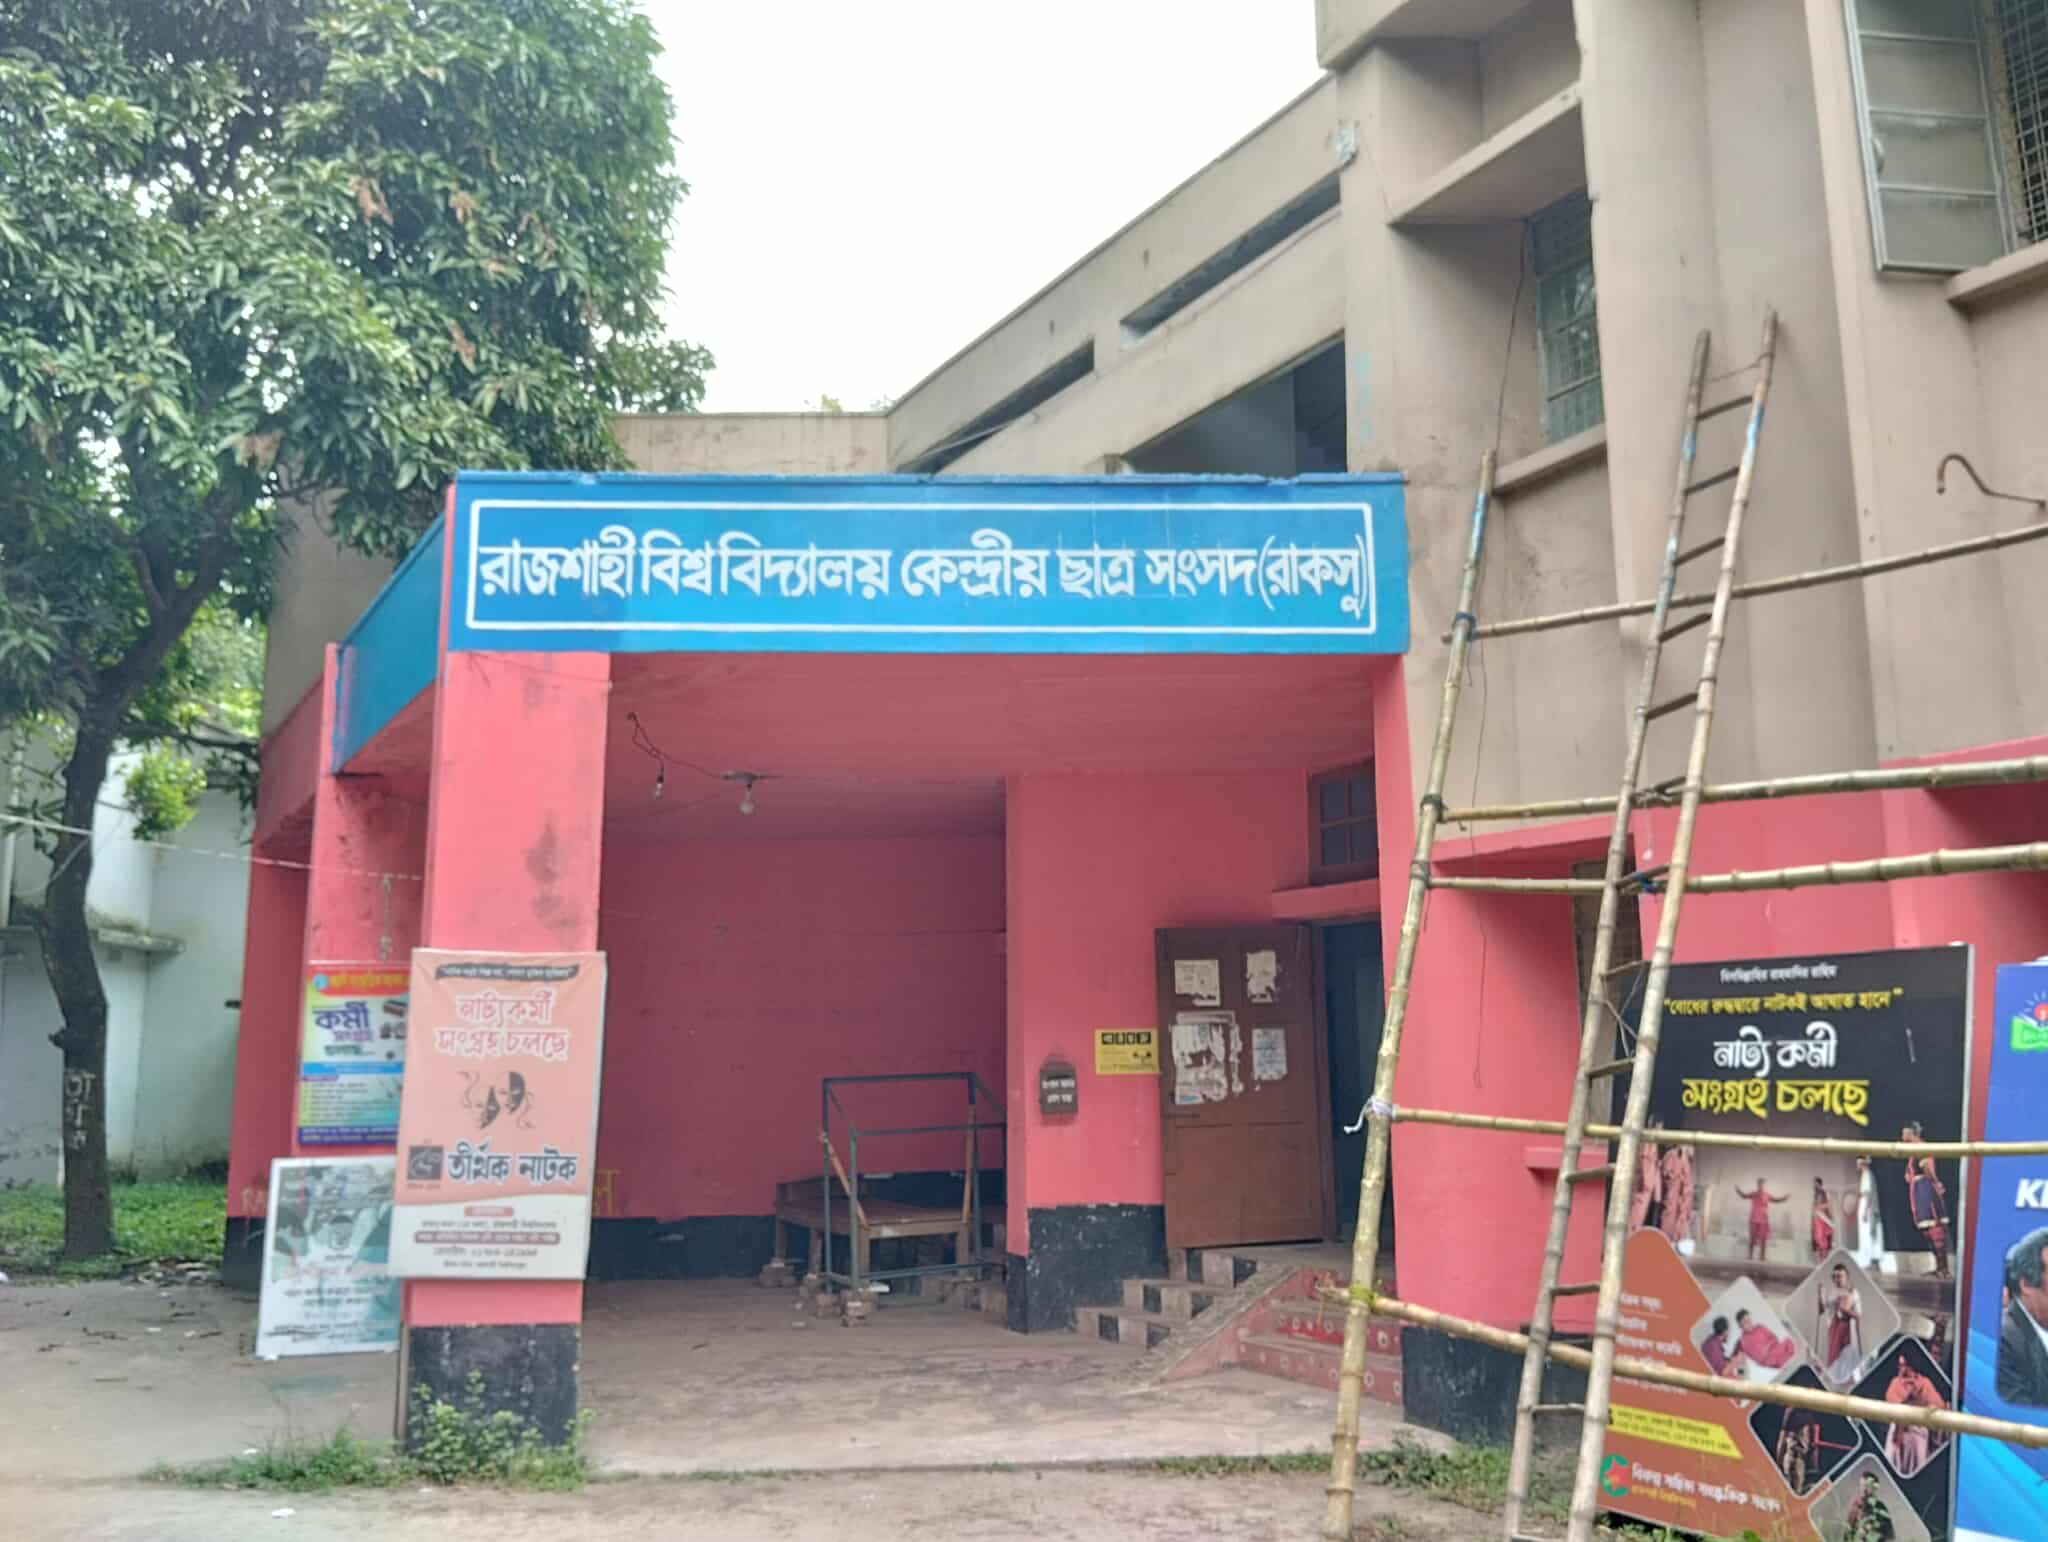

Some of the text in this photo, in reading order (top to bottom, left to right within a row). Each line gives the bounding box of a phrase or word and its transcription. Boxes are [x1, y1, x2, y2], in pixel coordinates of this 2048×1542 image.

[480, 525, 635, 598] রাজশাহী
[900, 528, 1050, 599] কেন্দ্রীয়
[1056, 542, 1135, 599] ছাত্র
[1713, 1021, 1838, 1078] নাট্য কর্মী
[1681, 1079, 1870, 1127] সংগ্রহ চলছে
[519, 1147, 578, 1182] নাটক
